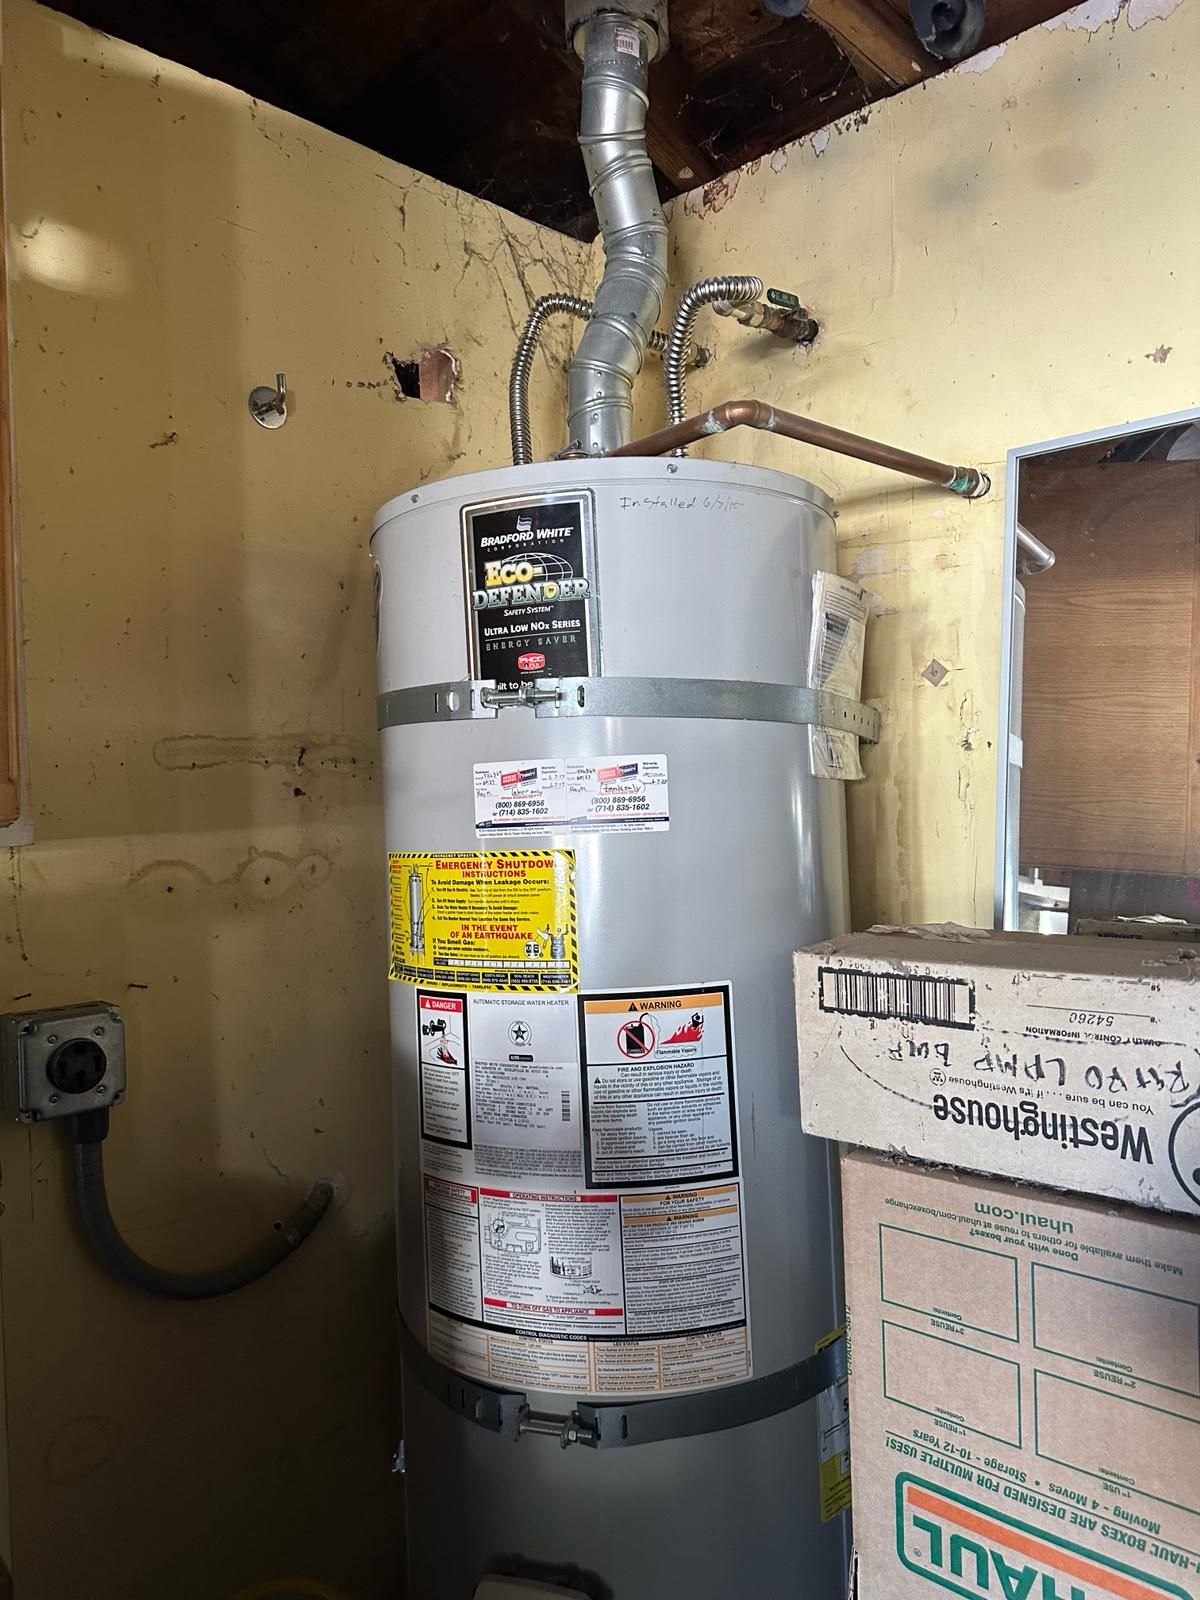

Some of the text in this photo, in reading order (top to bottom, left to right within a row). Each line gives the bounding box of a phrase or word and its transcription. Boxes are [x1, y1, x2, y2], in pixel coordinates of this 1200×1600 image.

[619, 496, 697, 511] Installed
[480, 527, 574, 548] BRADFORD WHITE
[473, 578, 591, 611] DEFENDER
[485, 635, 576, 652] ENERGY SAVER
[497, 682, 507, 690] ilt
[495, 800, 545, 809] (800) 869-6956
[591, 795, 646, 805] (800) 869-6956
[499, 809, 516, 817] (714)
[517, 807, 549, 815] 835-1602
[595, 804, 614, 813] (714)
[616, 803, 650, 811] 835-1602
[496, 858, 556, 869] SHUTDOW
[462, 870, 526, 878] INSTRUCTIONS
[431, 1001, 457, 1010] DANGER
[639, 1000, 682, 1010] WARNING
[1025, 1026, 1081, 1039] INFORMATION
[656, 1046, 697, 1055] Flammable Vapors
[948, 1076, 1017, 1095] Westinghouse
[1036, 1090, 1044, 1099] if
[1065, 1093, 1089, 1103] sure
[1092, 1097, 1106, 1109] be
[1108, 1100, 1129, 1110] can
[1132, 1103, 1154, 1116] You
[933, 1092, 1154, 1165] Westinghouse
[512, 1192, 577, 1202] OPERATING INSTRUCTIONS
[974, 1202, 1074, 1234] uhaul.com
[884, 1197, 1183, 1276] Make them available for others to reuse at uhaul.com/boxexchange
[969, 1228, 1079, 1262] Done with your boxes?
[560, 1307, 589, 1315] APPLIANCE
[932, 1307, 962, 1321] Contents:
[515, 1329, 538, 1337] CONTROL
[930, 1319, 955, 1332] REUSE
[1095, 1356, 1133, 1374] Contents:
[1093, 1369, 1123, 1386] REUSE
[934, 1406, 965, 1422] Contents:
[933, 1418, 958, 1433] REUSE
[885, 1436, 918, 1458] USES!
[919, 1451, 973, 1482] MULTIPLE
[912, 1429, 1160, 1535] Moving 4 Moves Storage 10-12 Years
[976, 1473, 1000, 1493] FOR
[1097, 1467, 1135, 1486] Contents:
[1102, 1481, 1121, 1496] USE
[1003, 1486, 1066, 1521] DESIGNED
[1070, 1511, 1098, 1531] ARE
[1101, 1524, 1147, 1552] BOXES
